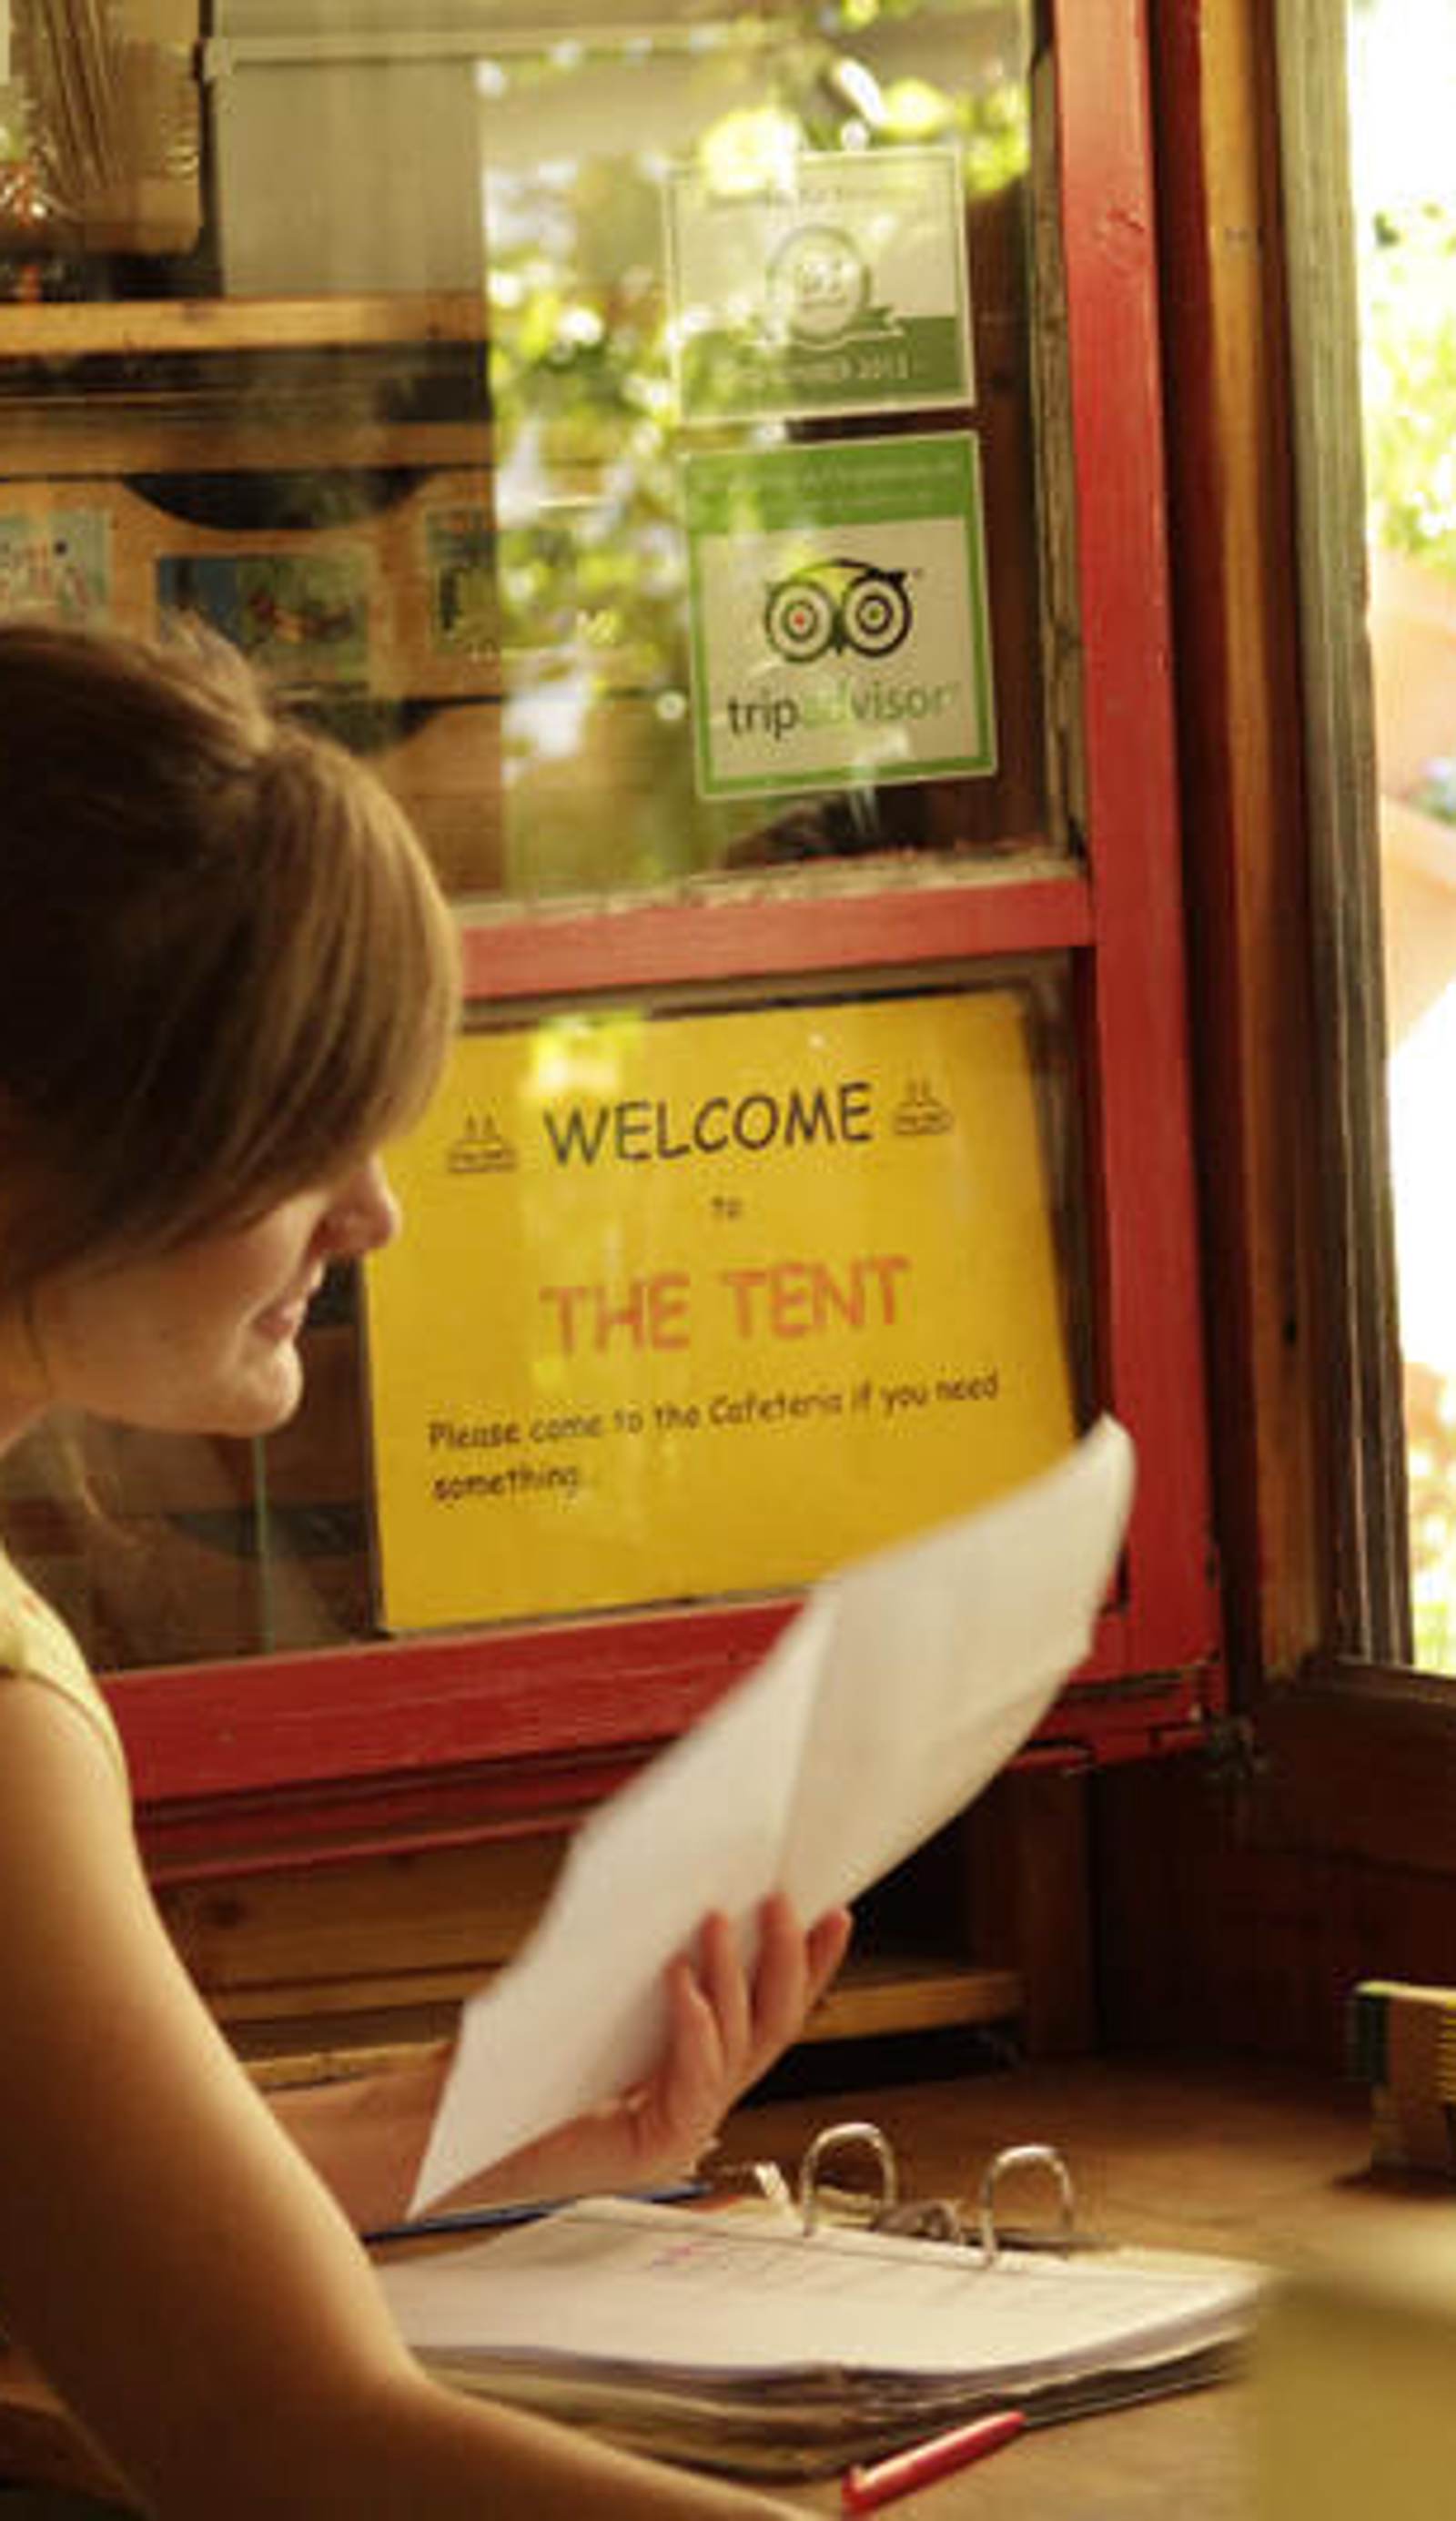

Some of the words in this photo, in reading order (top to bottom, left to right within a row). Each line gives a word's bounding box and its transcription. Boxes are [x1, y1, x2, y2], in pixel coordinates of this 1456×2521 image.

[543, 1081, 874, 1167] WELCOME
[711, 1195, 743, 1223] to
[540, 1271, 692, 1358] THE
[719, 1253, 911, 1343] TENT
[429, 1420, 521, 1452] Please
[529, 1414, 602, 1444] come
[612, 1407, 644, 1435] to
[652, 1401, 701, 1432] the
[708, 1387, 843, 1425] Cafeteria
[850, 1378, 873, 1412] if
[879, 1382, 927, 1420] you
[935, 1367, 998, 1402] need
